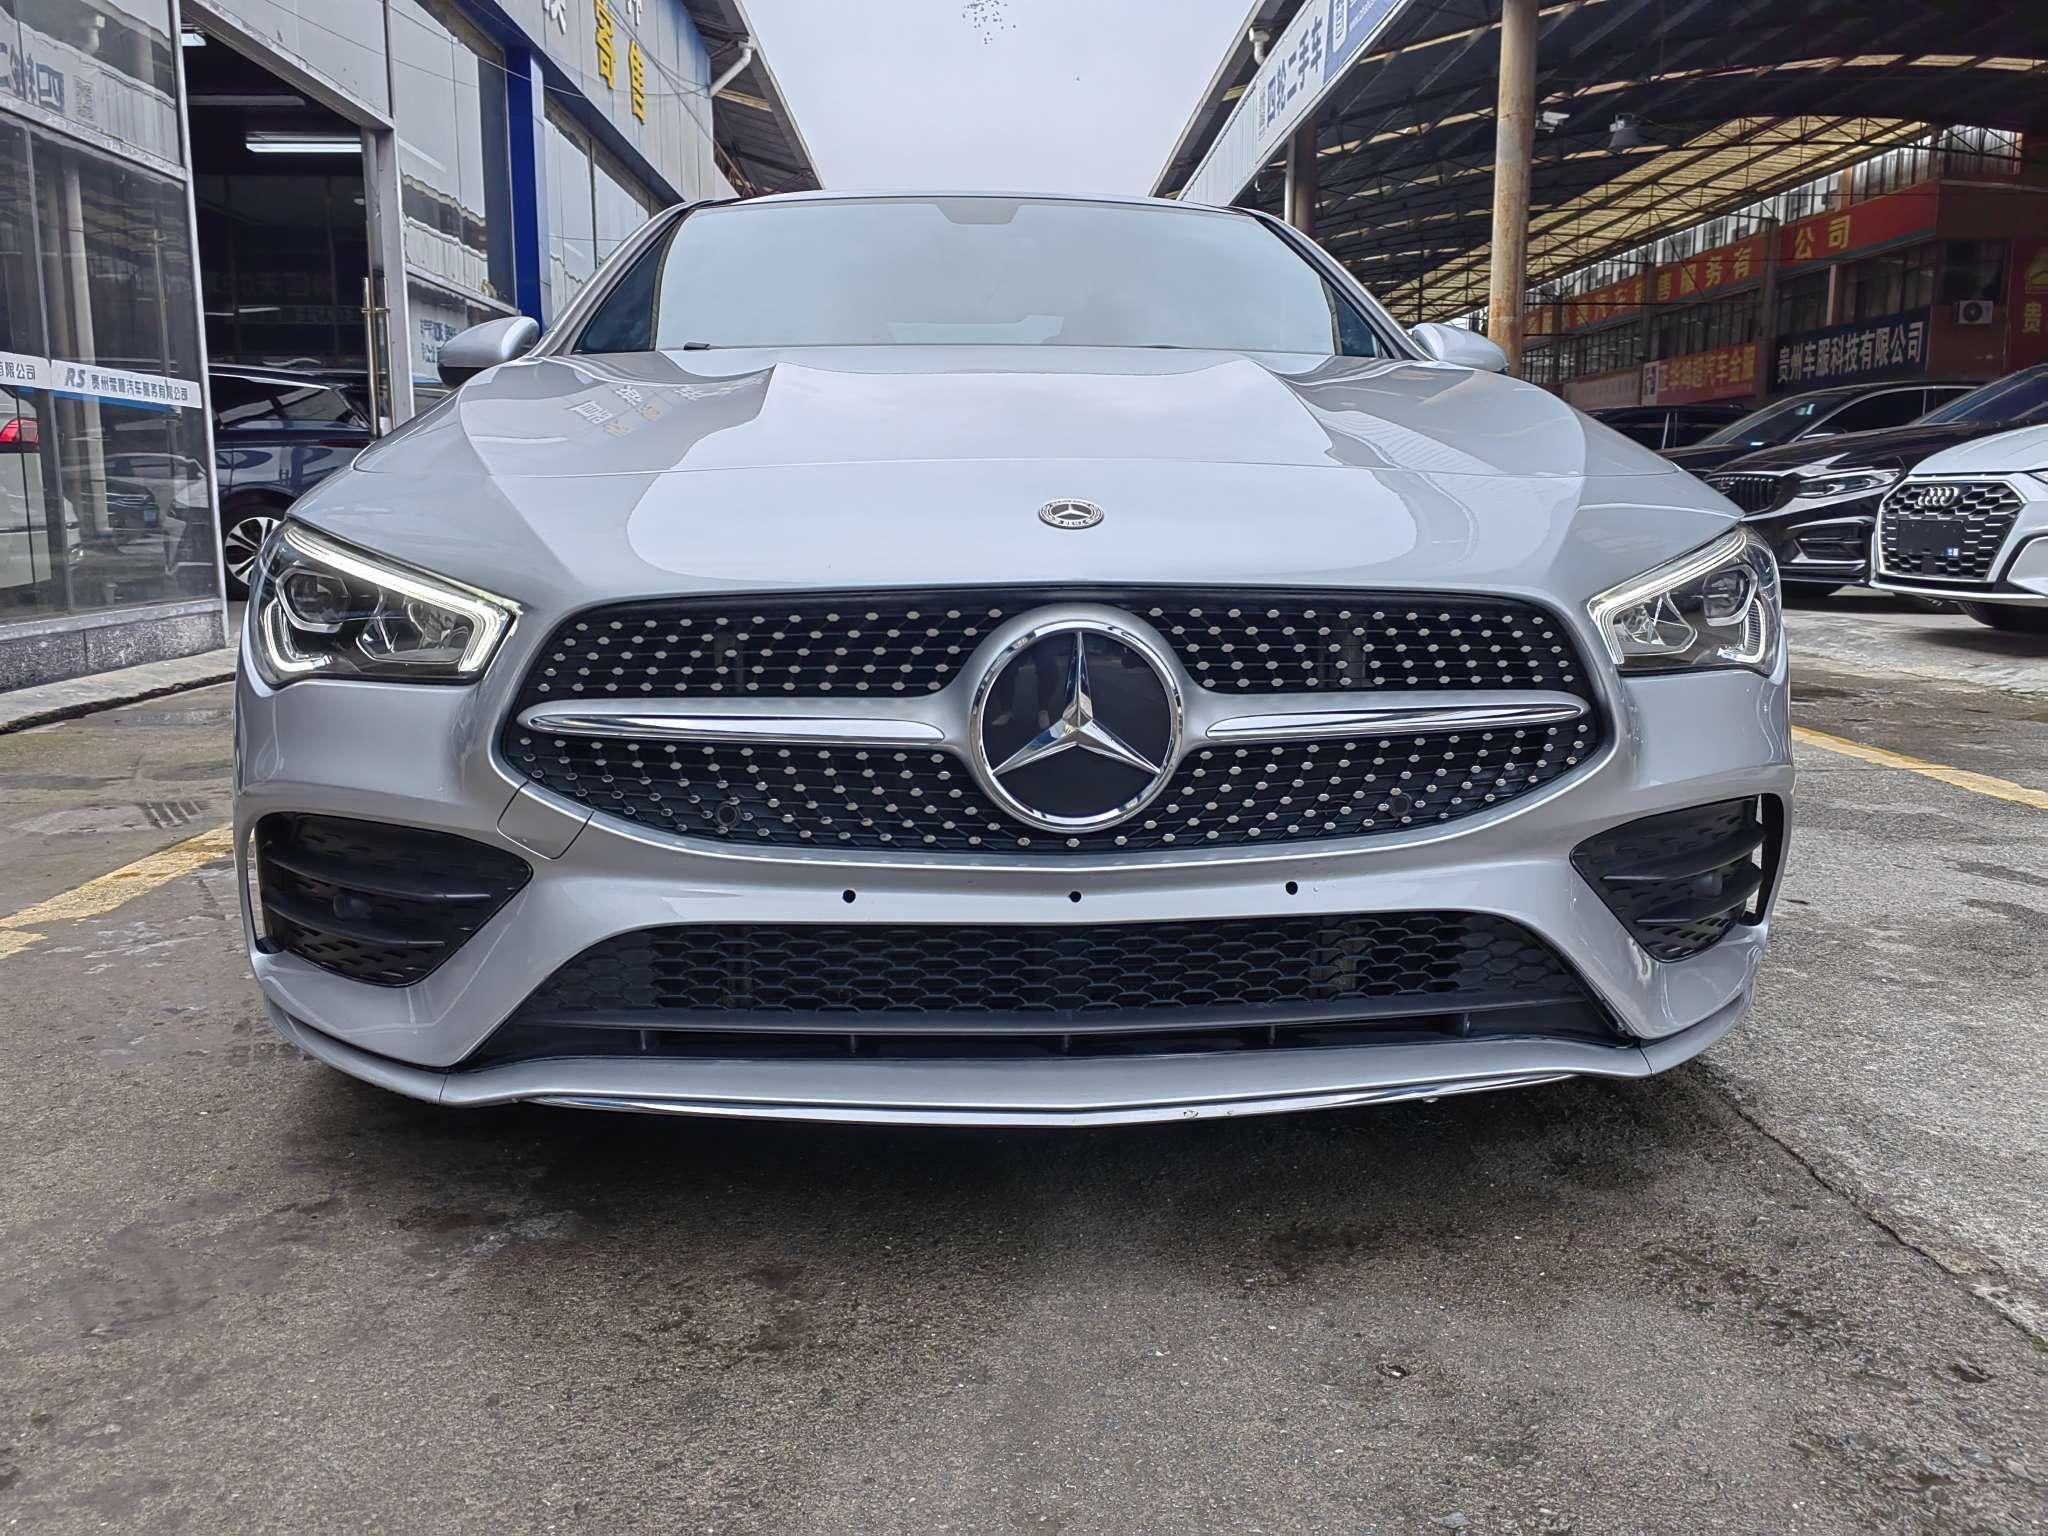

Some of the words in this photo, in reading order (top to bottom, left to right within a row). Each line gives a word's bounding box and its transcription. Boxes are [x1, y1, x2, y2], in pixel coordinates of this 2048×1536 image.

[1777, 321, 1924, 384] 贵州车服科技有限公司
[65, 367, 87, 389] RS
